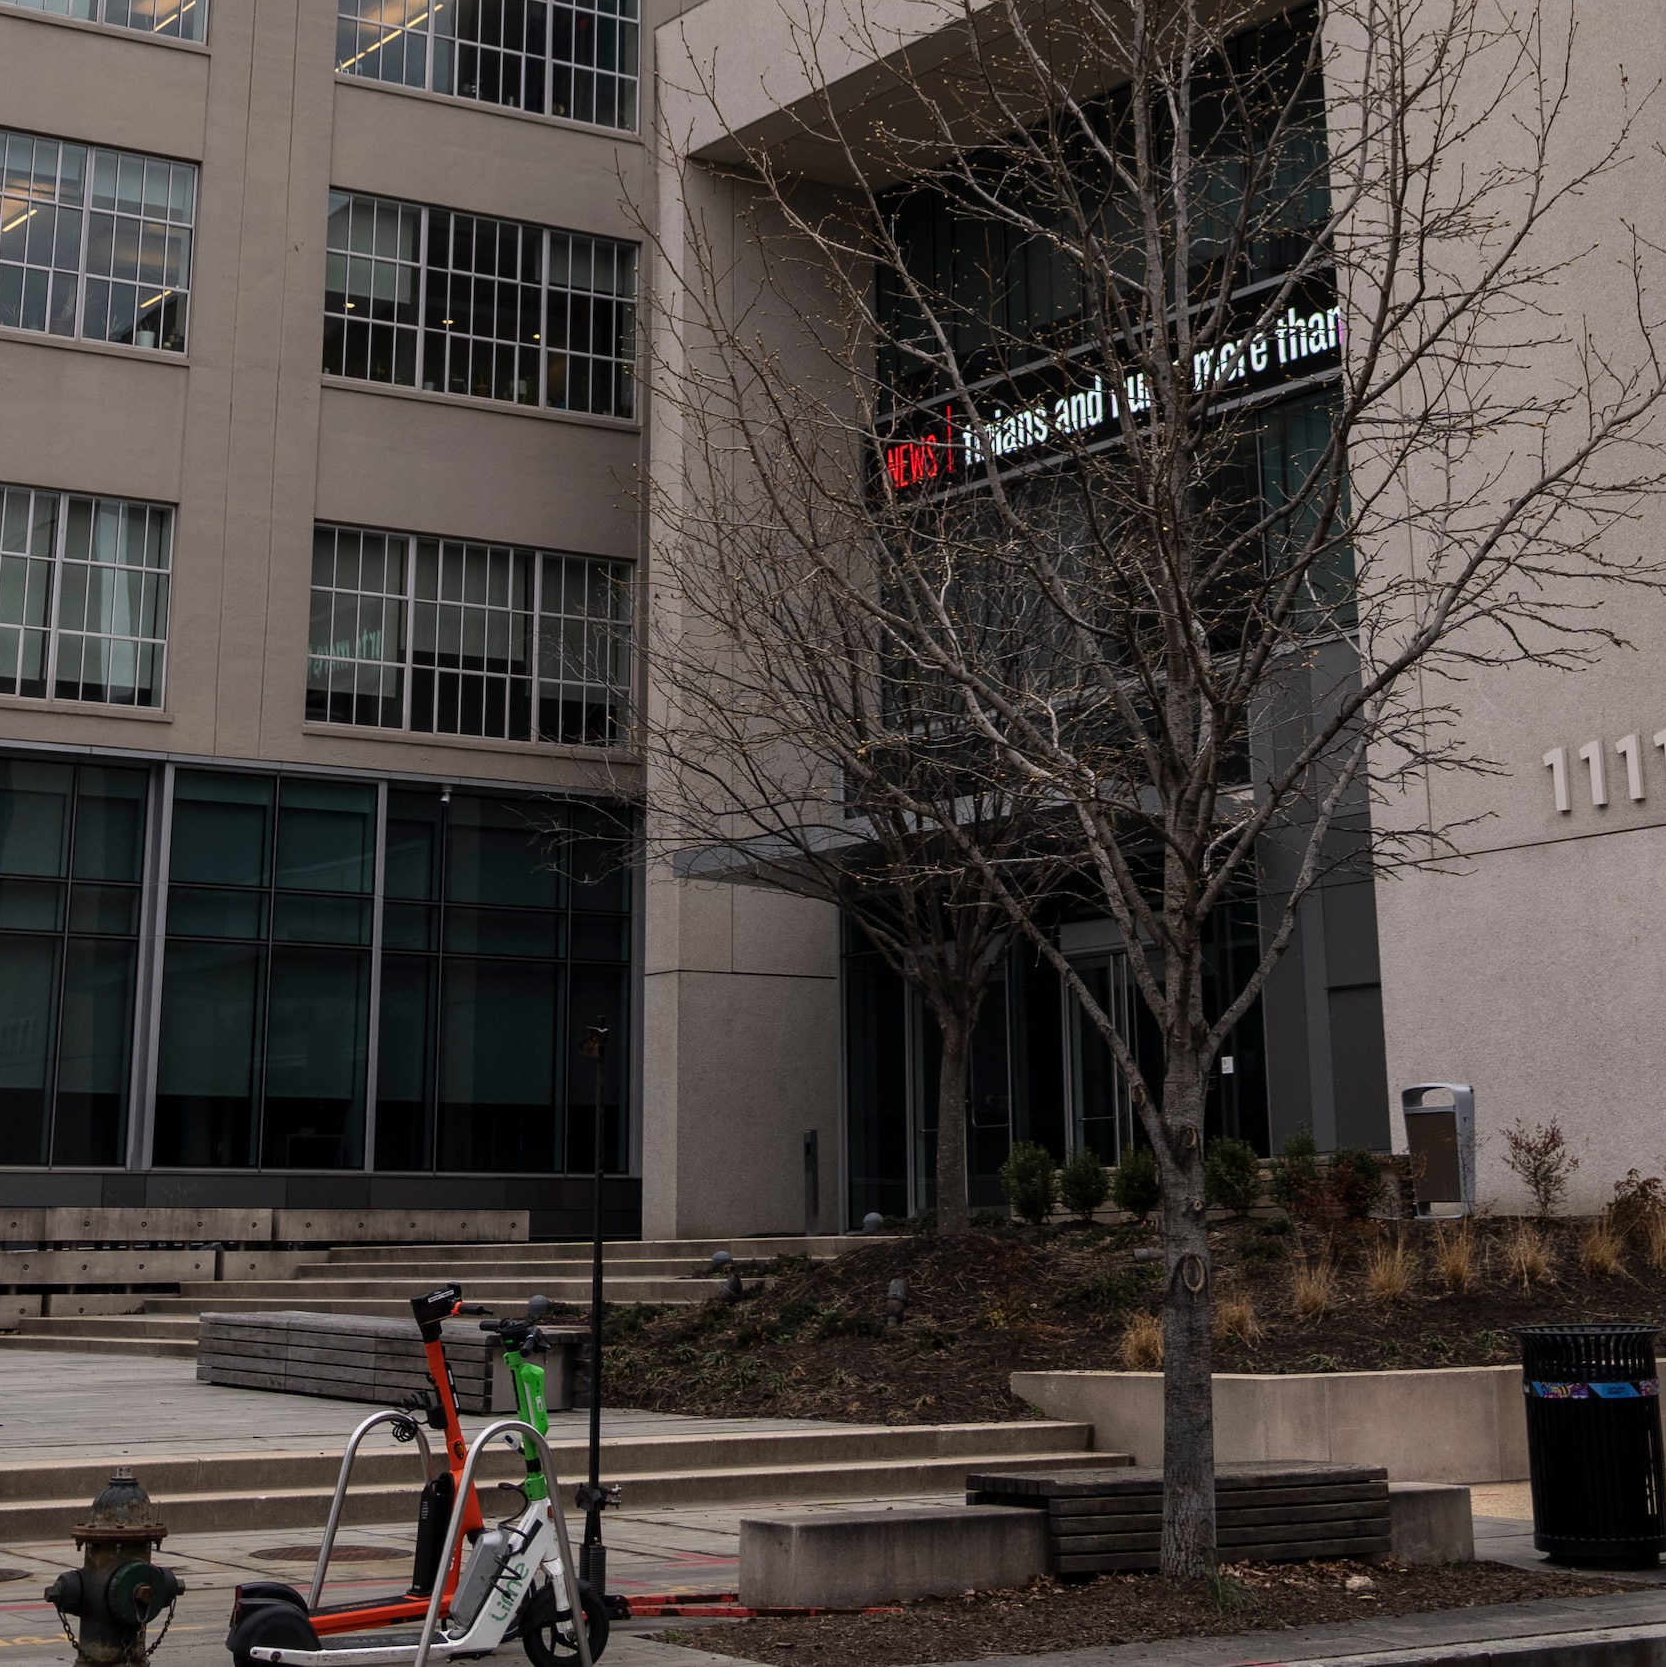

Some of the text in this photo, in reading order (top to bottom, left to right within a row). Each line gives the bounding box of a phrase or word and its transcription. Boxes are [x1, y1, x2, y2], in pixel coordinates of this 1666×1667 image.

[887, 433, 938, 489] NEWS
[1054, 374, 1104, 434] and
[1193, 332, 1269, 392] more
[1275, 306, 1342, 364] than
[489, 1562, 529, 1622] Lime
